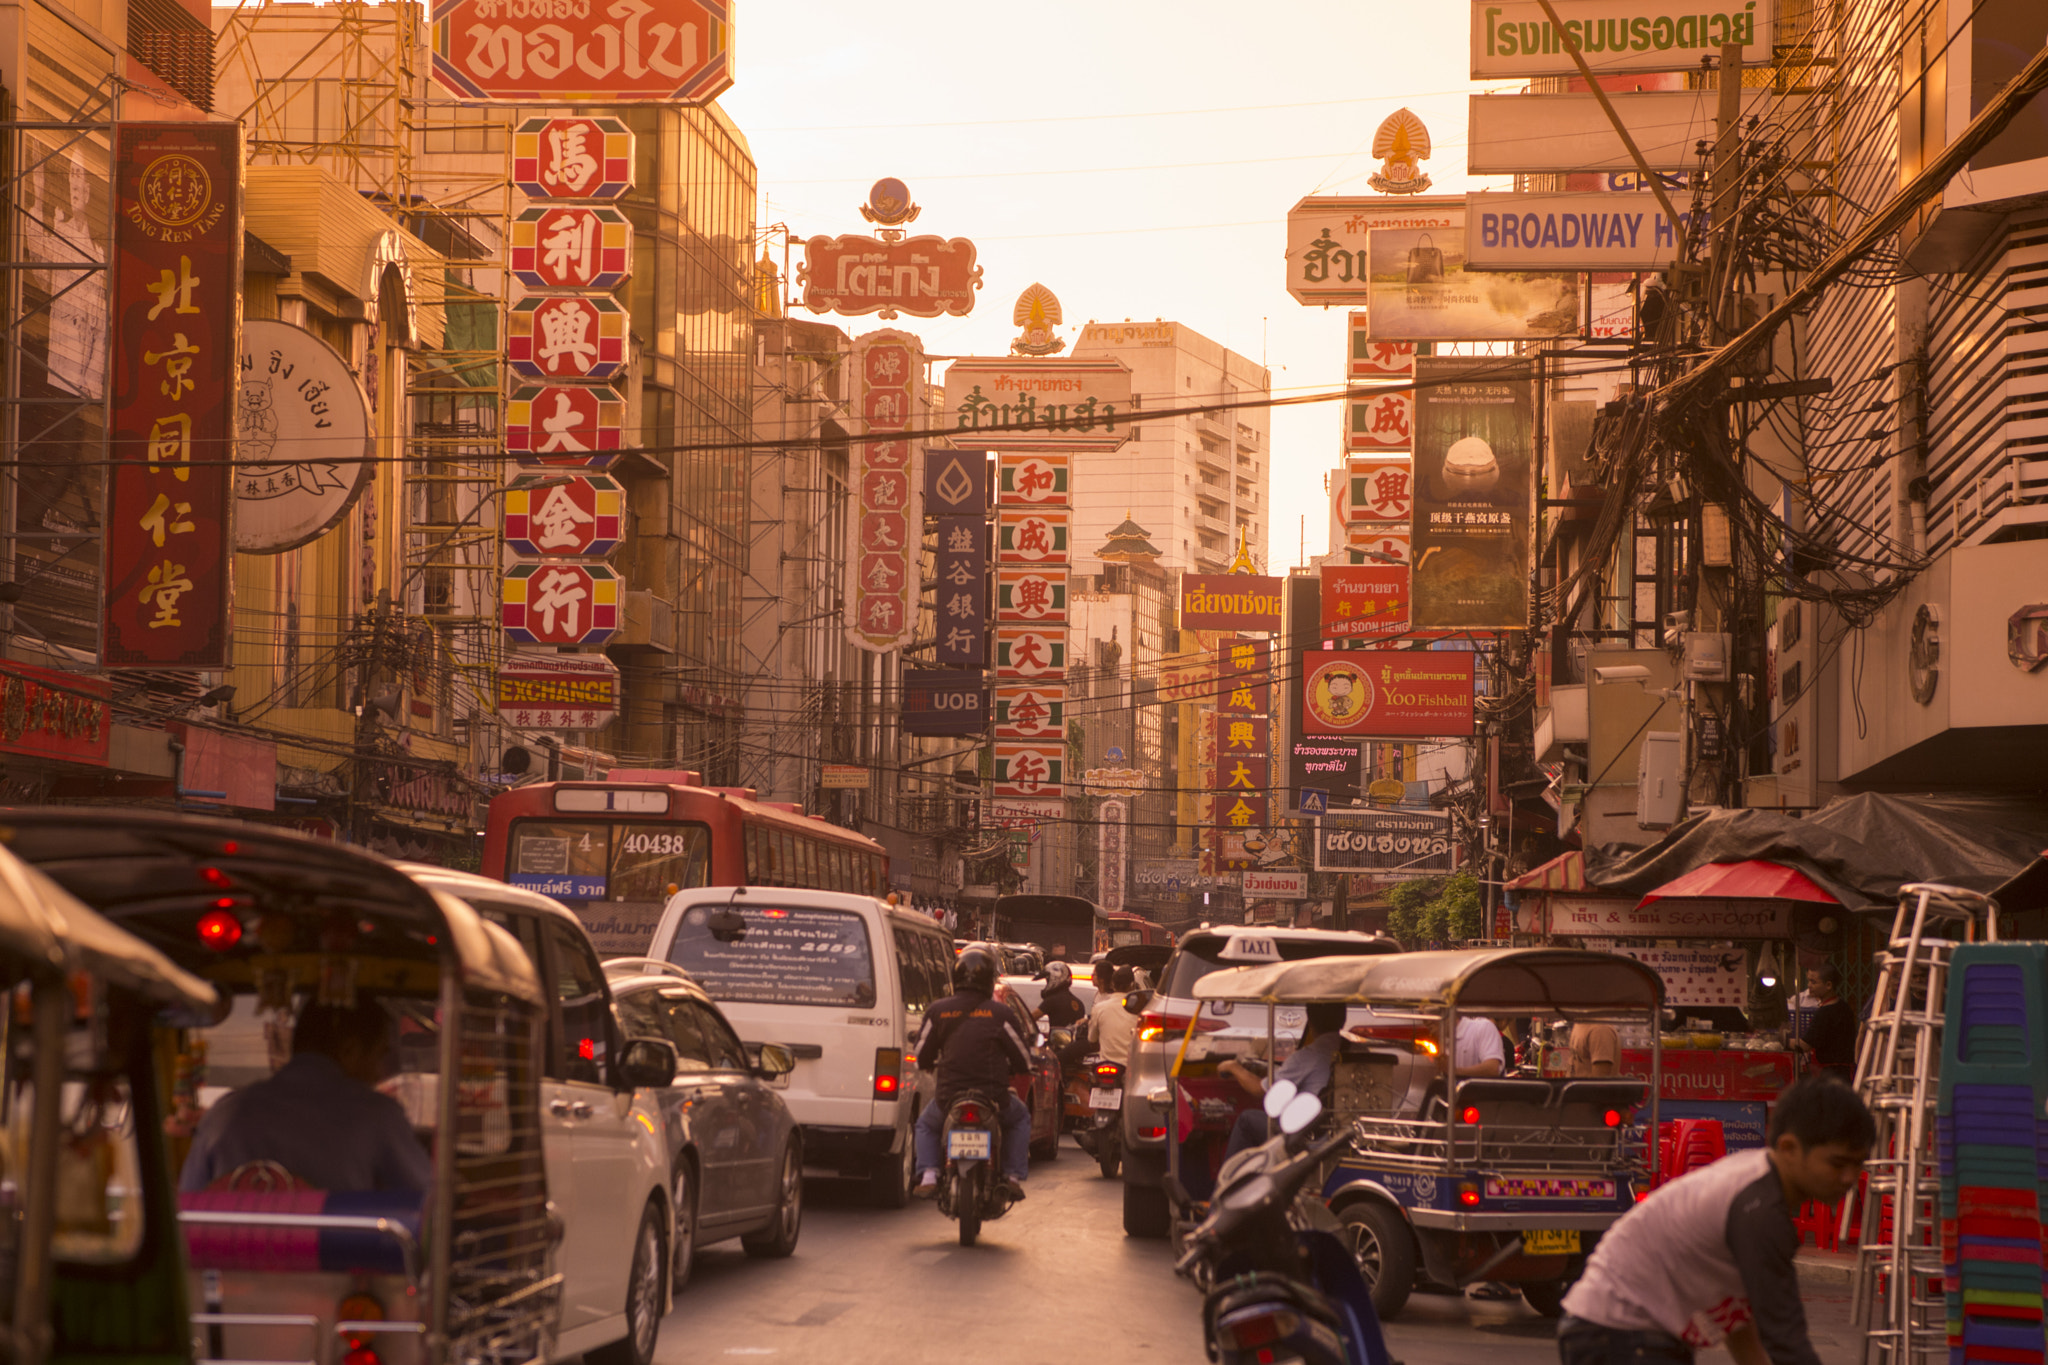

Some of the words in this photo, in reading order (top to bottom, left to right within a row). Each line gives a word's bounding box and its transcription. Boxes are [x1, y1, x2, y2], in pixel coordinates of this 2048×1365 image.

[474, 0, 591, 20] หางทอง
[126, 201, 157, 237] TONG
[160, 227, 193, 243] REN
[192, 202, 225, 235] TANG
[1481, 213, 1644, 249] BROADWAY
[836, 252, 940, 297] โต๊ะกัง
[531, 122, 599, 639] 馬利興大金行
[993, 374, 1083, 392] ห้างขายทอง
[138, 254, 201, 630] 北京同仁堂
[943, 524, 978, 655] 盤谷銀行
[1332, 578, 1399, 594] ร้านขายยา
[1009, 462, 1055, 792] 和成興大金行
[1331, 621, 1349, 633] LIM
[1351, 621, 1379, 633] SOON
[1381, 621, 1410, 633] HENG
[1393, 668, 1467, 683] ลูกชิ้นปลาเยาวราช
[500, 679, 613, 703] EXCHANGE
[1418, 694, 1467, 706] Fishball
[934, 693, 979, 710] UOB
[1225, 643, 1257, 869] 聯成興大金
[1293, 743, 1358, 757] ข้ารองพระบาท
[1304, 759, 1347, 774] ทุกชาติไป
[578, 832, 592, 852] 4
[623, 834, 685, 855] 40438
[577, 884, 606, 897] จาก
[1606, 912, 1621, 924] &
[1667, 911, 1769, 926] SEAFOOD
[799, 941, 858, 955] 2559
[1240, 939, 1271, 955] TAXI
